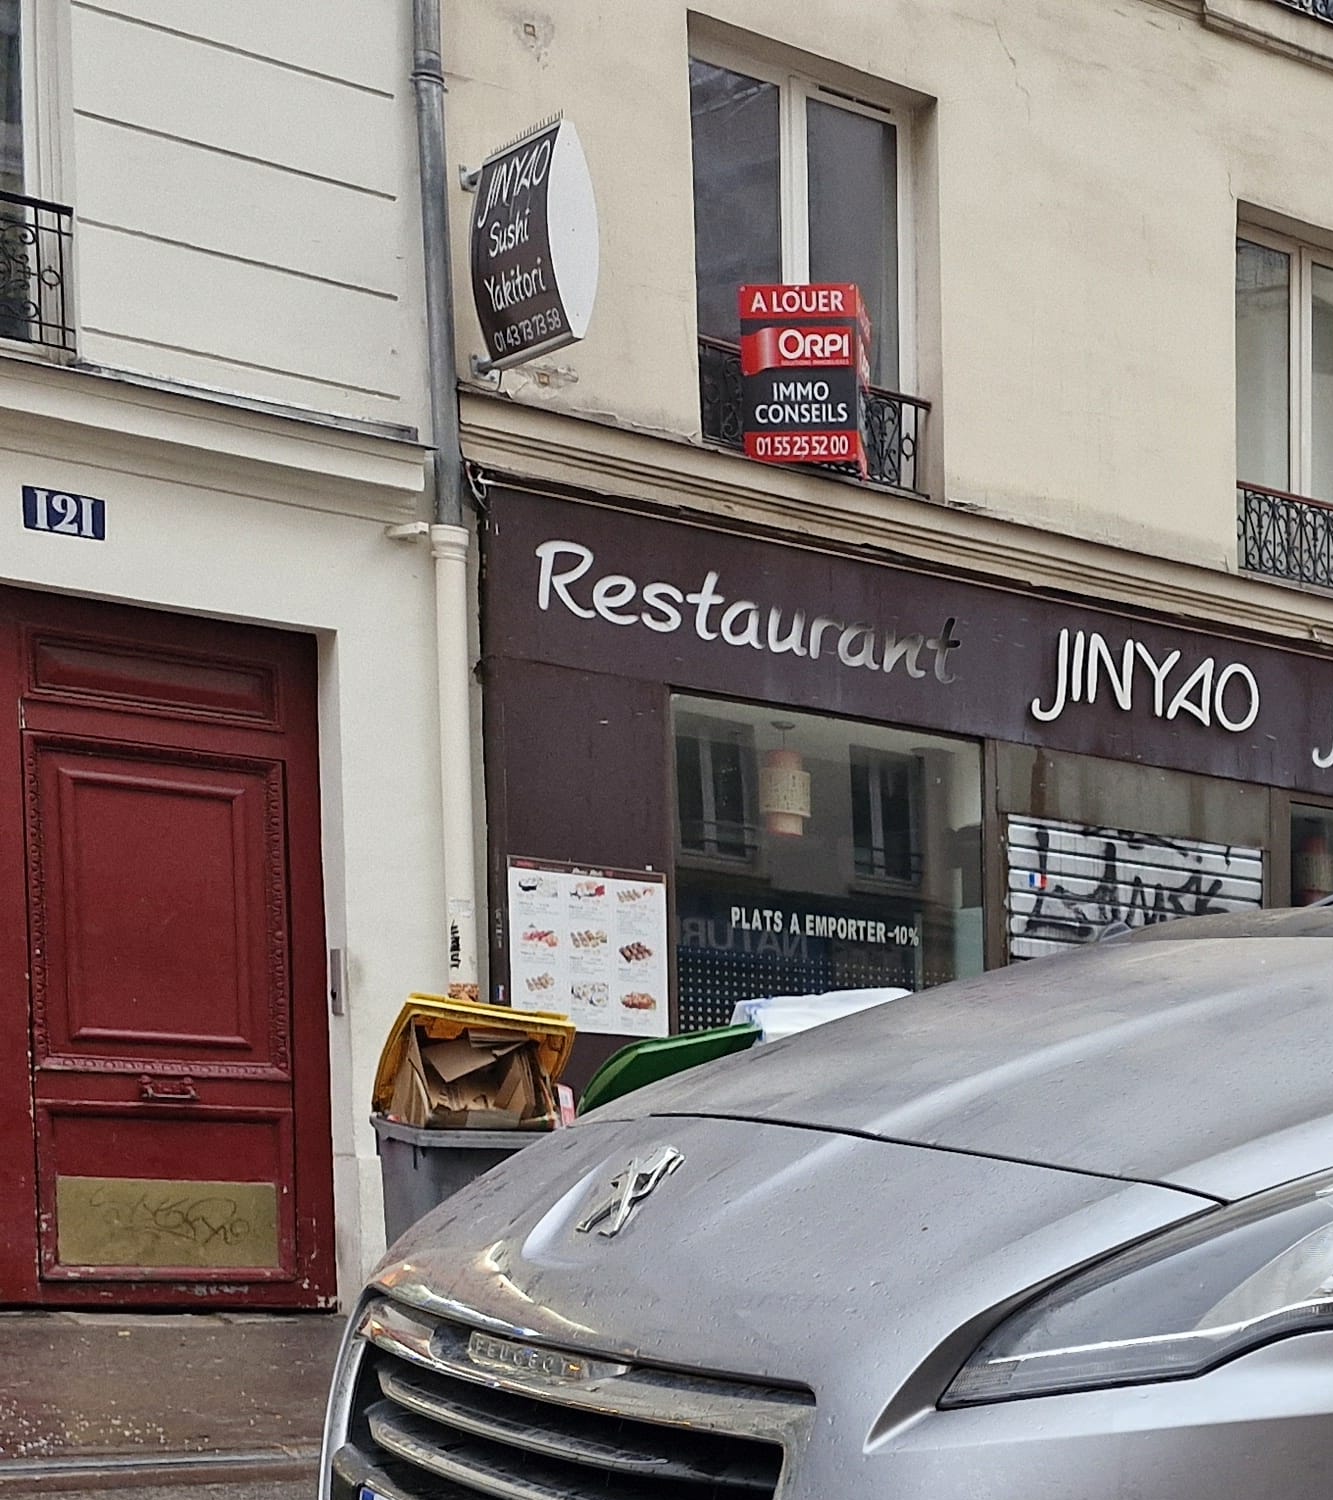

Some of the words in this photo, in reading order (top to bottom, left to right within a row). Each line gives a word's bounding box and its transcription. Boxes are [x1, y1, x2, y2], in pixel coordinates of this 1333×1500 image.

[478, 139, 551, 229] JINYAO
[488, 208, 530, 257] Sushi
[484, 257, 547, 313] Yakitori
[750, 291, 768, 313] A
[772, 290, 844, 313] LOUER
[493, 331, 506, 353] 01
[506, 323, 521, 348] 43
[519, 320, 534, 344] 73
[532, 314, 547, 338] 73
[547, 307, 562, 331] 58
[778, 328, 849, 360] ORPI
[755, 402, 848, 424] CONSEILS
[772, 381, 829, 401] IMMO
[756, 437, 772, 456] 01
[774, 436, 791, 455] 55
[792, 436, 810, 455] 25
[811, 436, 828, 455] 52
[830, 436, 848, 455] 00
[33, 488, 95, 538] 121
[535, 539, 961, 684] Restaurant
[1031, 627, 1260, 733] JINYAO
[731, 906, 783, 933] PLATS
[789, 912, 800, 935] A
